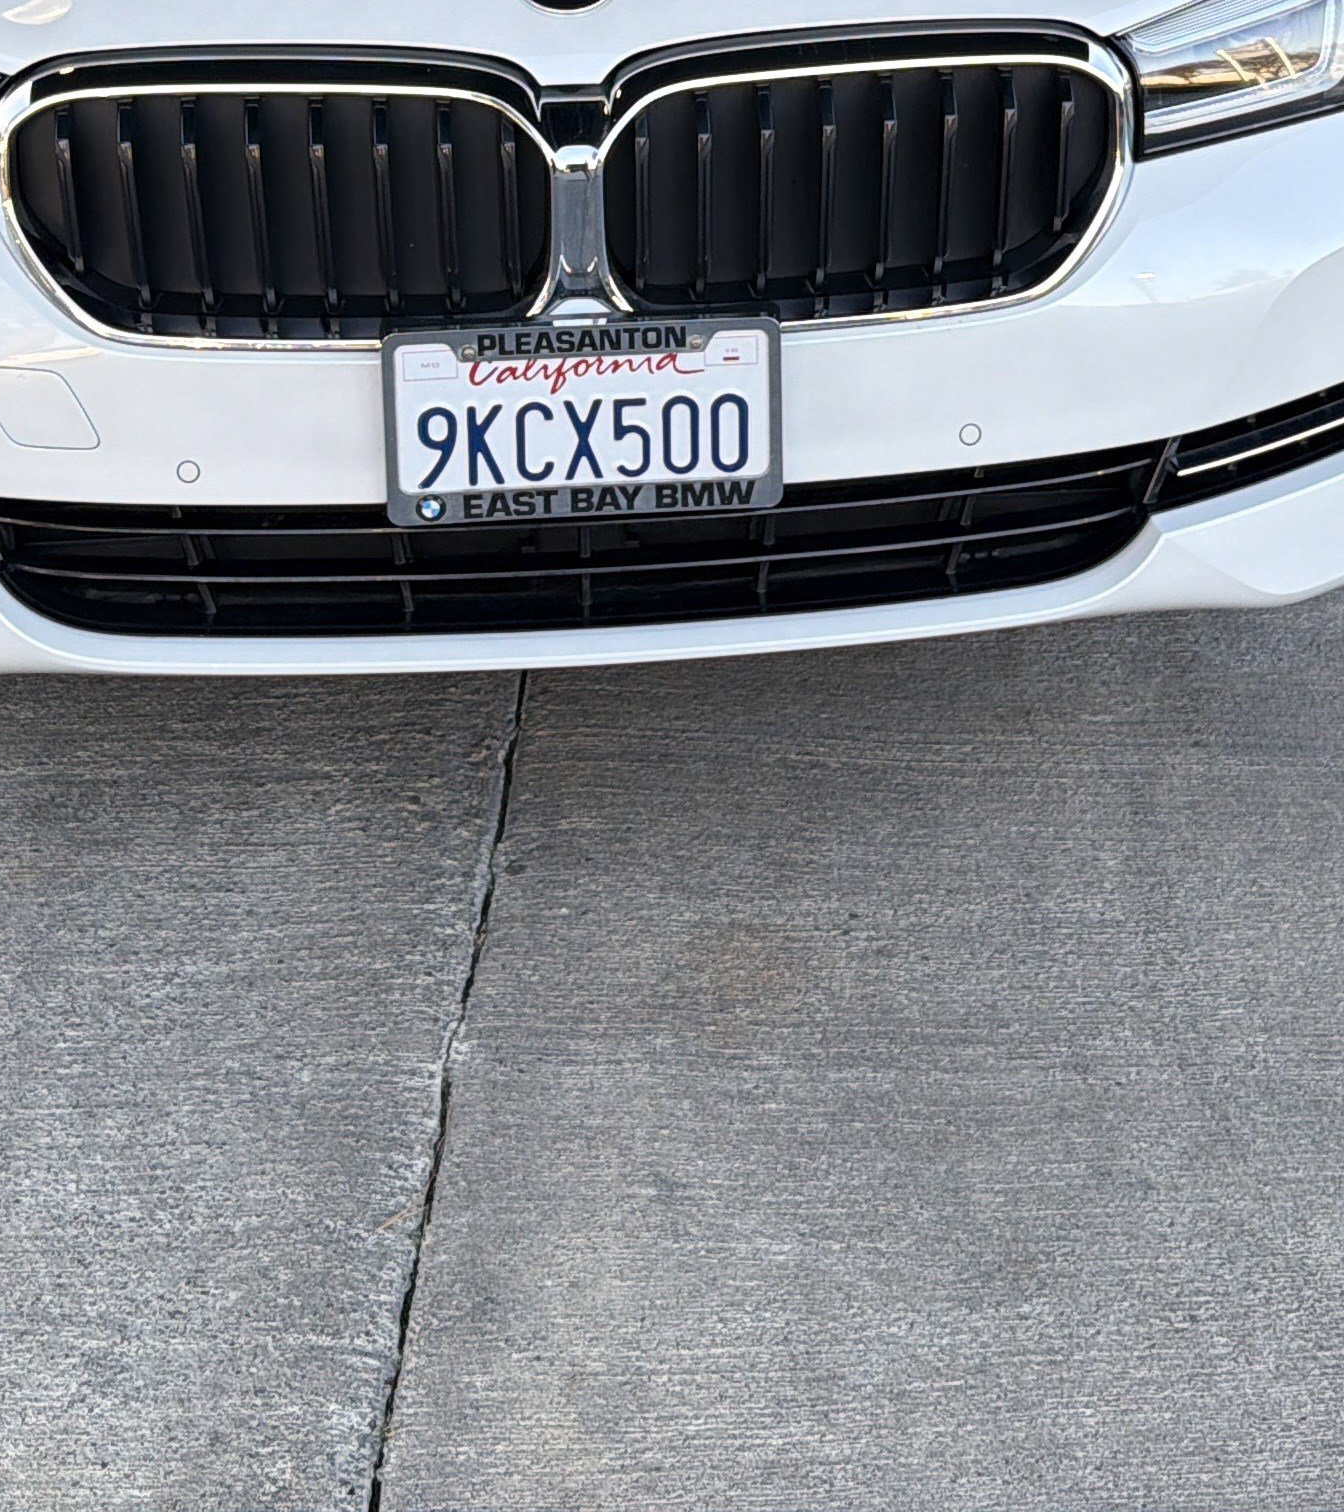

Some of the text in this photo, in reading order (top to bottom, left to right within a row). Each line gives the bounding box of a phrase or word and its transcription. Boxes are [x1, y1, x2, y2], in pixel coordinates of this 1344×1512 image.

[477, 325, 687, 357] PLEASANTON
[469, 352, 705, 395] California
[417, 393, 749, 488] 9KCX500
[463, 480, 756, 519] EAST BAY BMW
